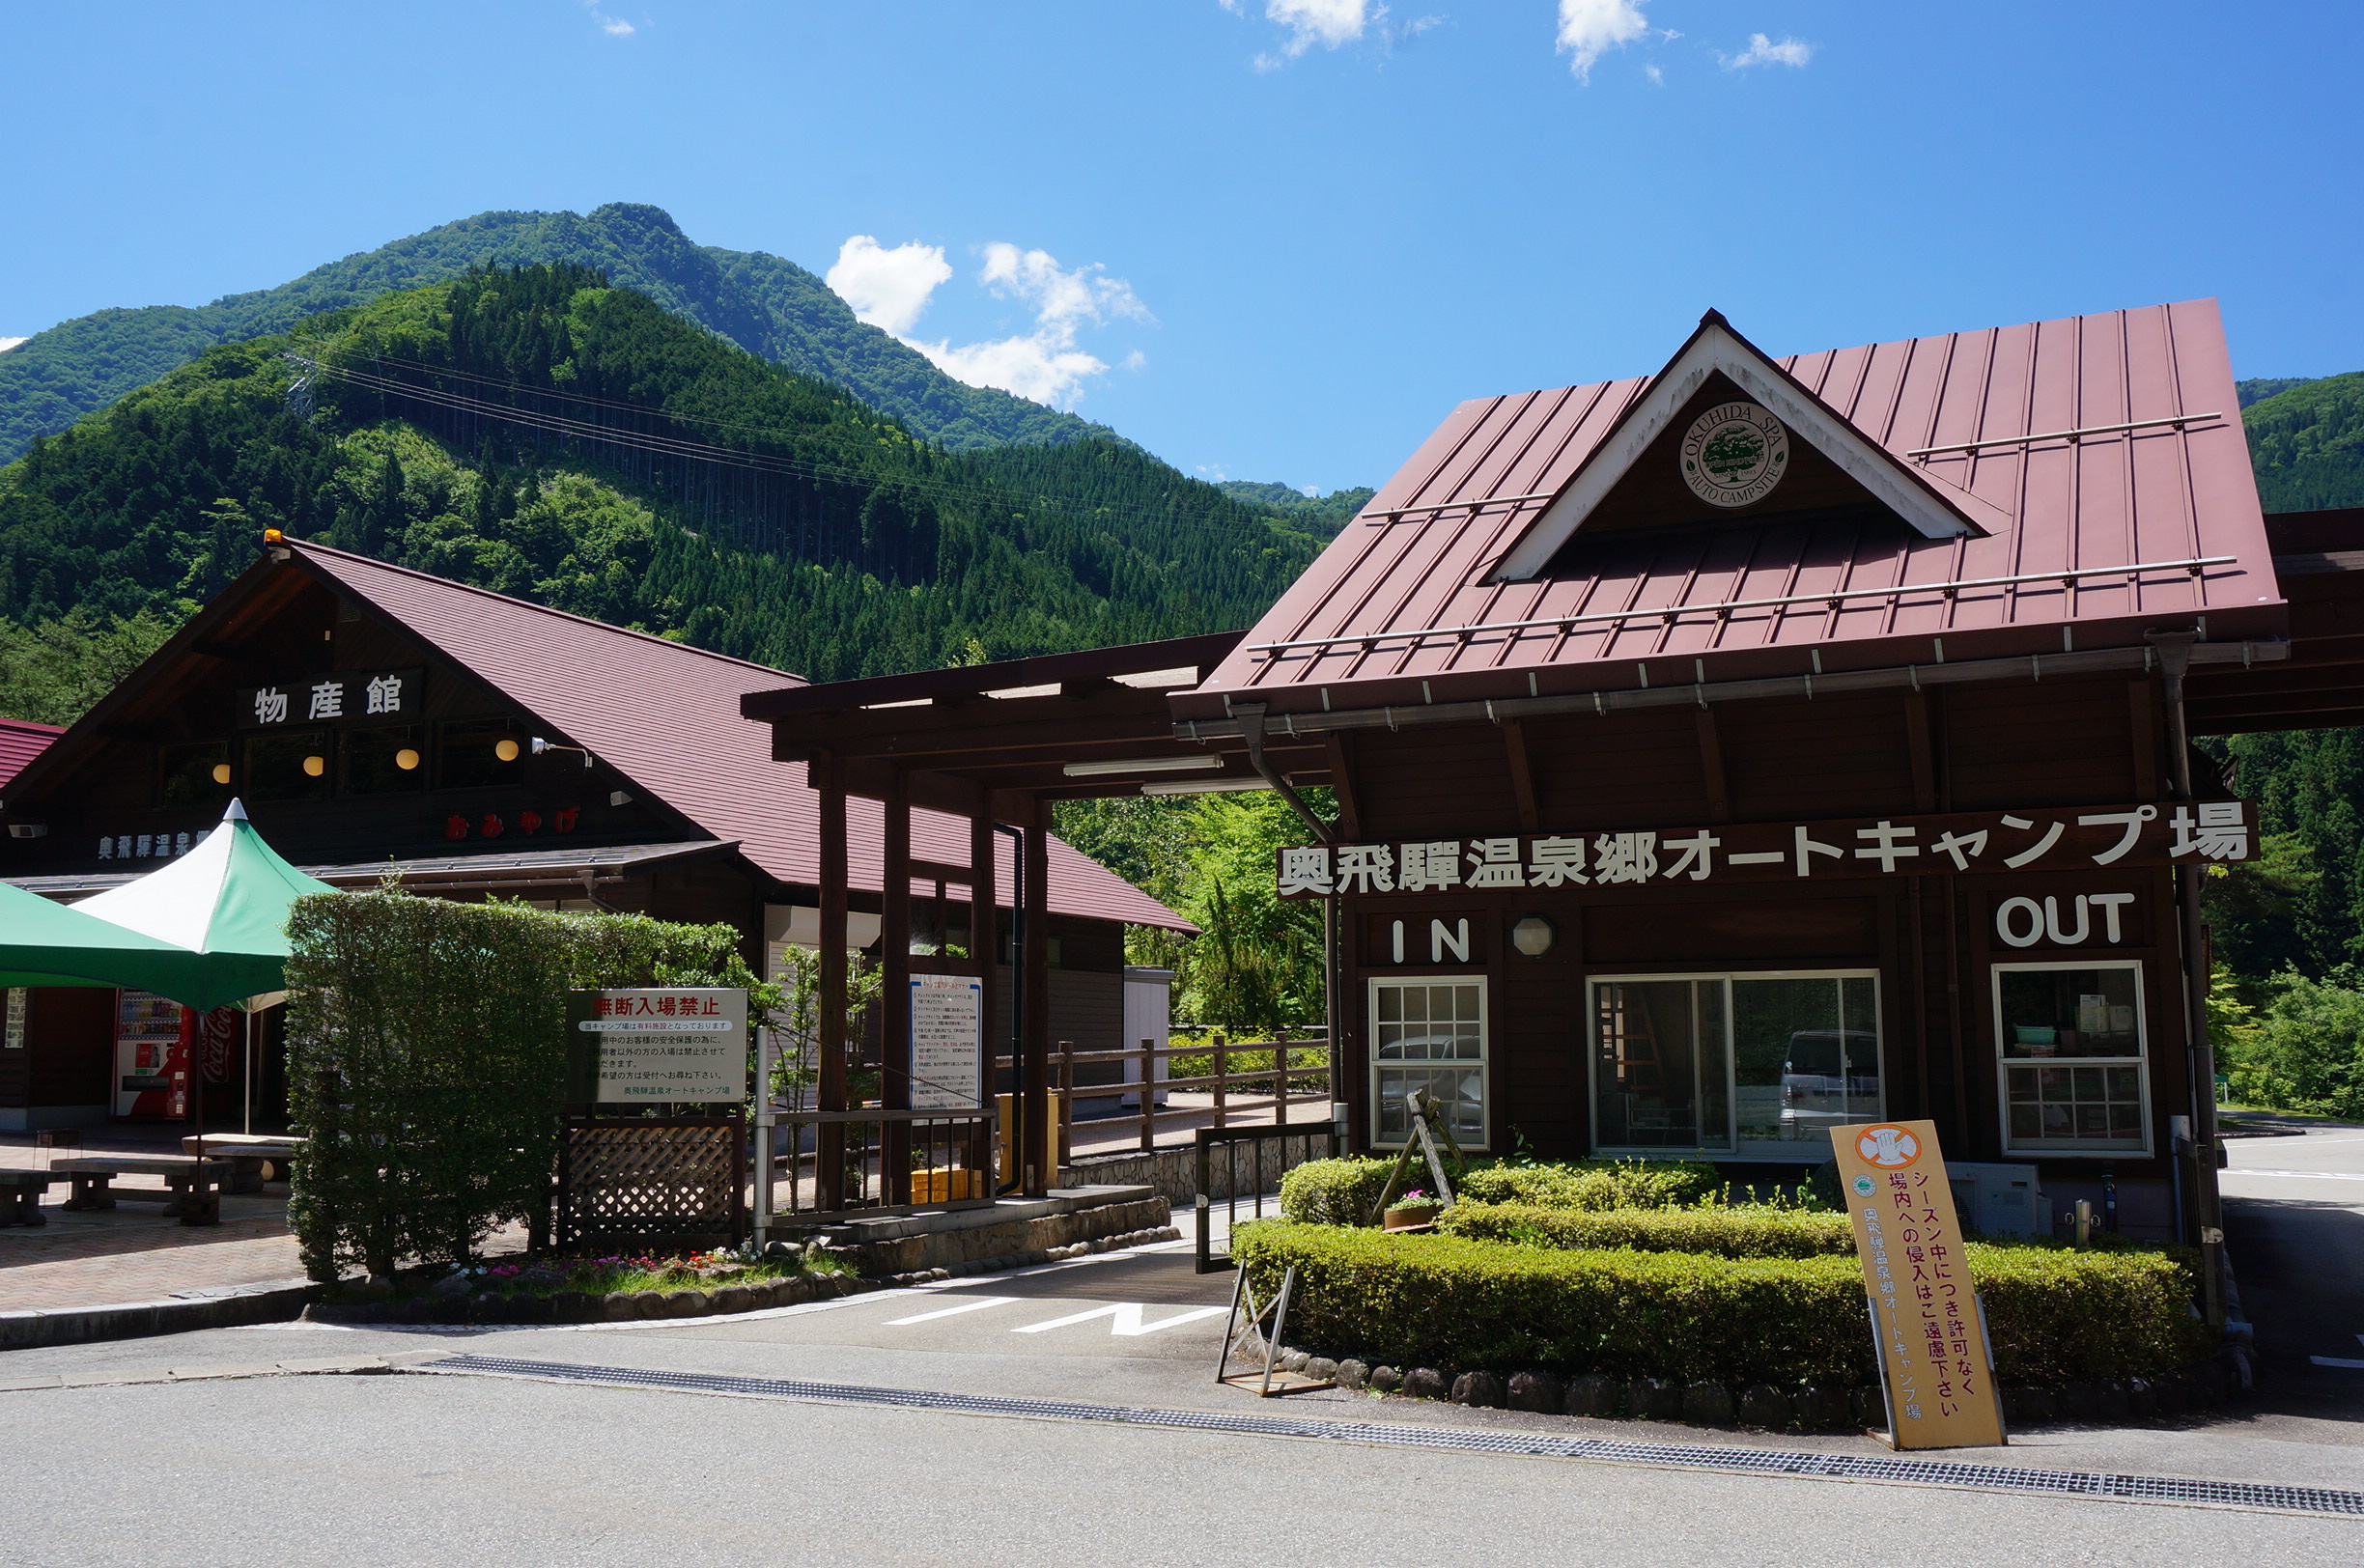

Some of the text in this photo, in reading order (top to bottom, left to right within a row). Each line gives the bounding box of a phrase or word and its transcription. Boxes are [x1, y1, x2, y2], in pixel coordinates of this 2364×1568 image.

[1685, 406, 1783, 457] OKUHIDA SPA
[1689, 467, 1780, 503] AUTO CAMP SITE
[254, 675, 403, 724] 物産館
[1393, 917, 1470, 964] IN
[1996, 893, 2135, 947] OUT
[593, 996, 721, 1017] 無断入場禁止
[585, 1035, 722, 1046] 用中のお客様の安全保護の為に、
[585, 1047, 726, 1056] 用者以外の方の入場は禁止させて
[1888, 1171, 1958, 1417] 場内への侵入はご遠慮下さい
[1913, 1171, 1975, 1396] シーズン中につき許可なく
